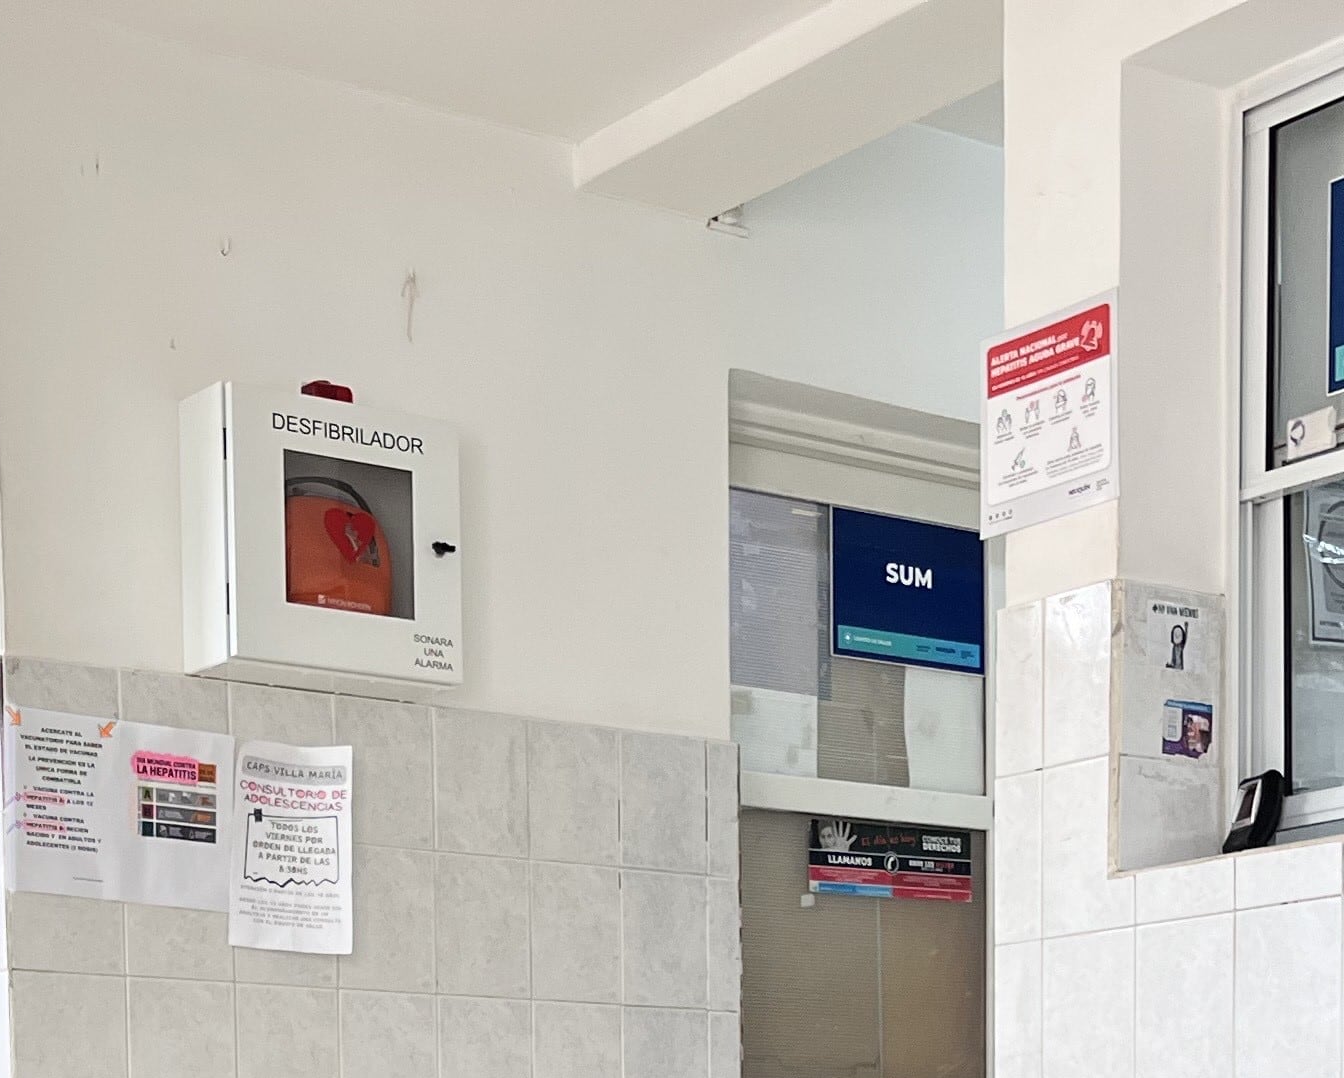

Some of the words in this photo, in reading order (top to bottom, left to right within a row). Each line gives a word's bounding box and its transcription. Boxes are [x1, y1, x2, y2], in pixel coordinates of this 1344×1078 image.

[1019, 335, 1056, 356] NACIONAL
[991, 357, 1027, 378] HEPATITIS
[1029, 347, 1055, 364] AGUDA
[272, 412, 424, 455] DESFIBRILADOR
[886, 562, 933, 589] SUM
[414, 633, 453, 648] SONARA
[424, 648, 444, 658] UNA
[414, 658, 453, 672] ALARMA
[137, 765, 148, 774] LA
[150, 766, 197, 780] HEPATITIS
[247, 761, 270, 773] CAPS
[274, 766, 304, 778] VILLA
[309, 768, 342, 779] MARÍA
[143, 789, 151, 799] A
[240, 780, 327, 799] CONSULTORIO
[332, 790, 347, 799] DE
[244, 793, 343, 811] ADOLESCENCIAS
[271, 822, 299, 832] TODOS
[302, 825, 318, 833] LOS
[266, 832, 302, 843] VIERNES
[305, 836, 323, 844] POR
[253, 840, 281, 851] ORDEN
[284, 844, 295, 852] DE
[298, 846, 336, 855] LLEGADA
[266, 852, 297, 863] PARTIR
[828, 854, 873, 867] LLAMANOS
